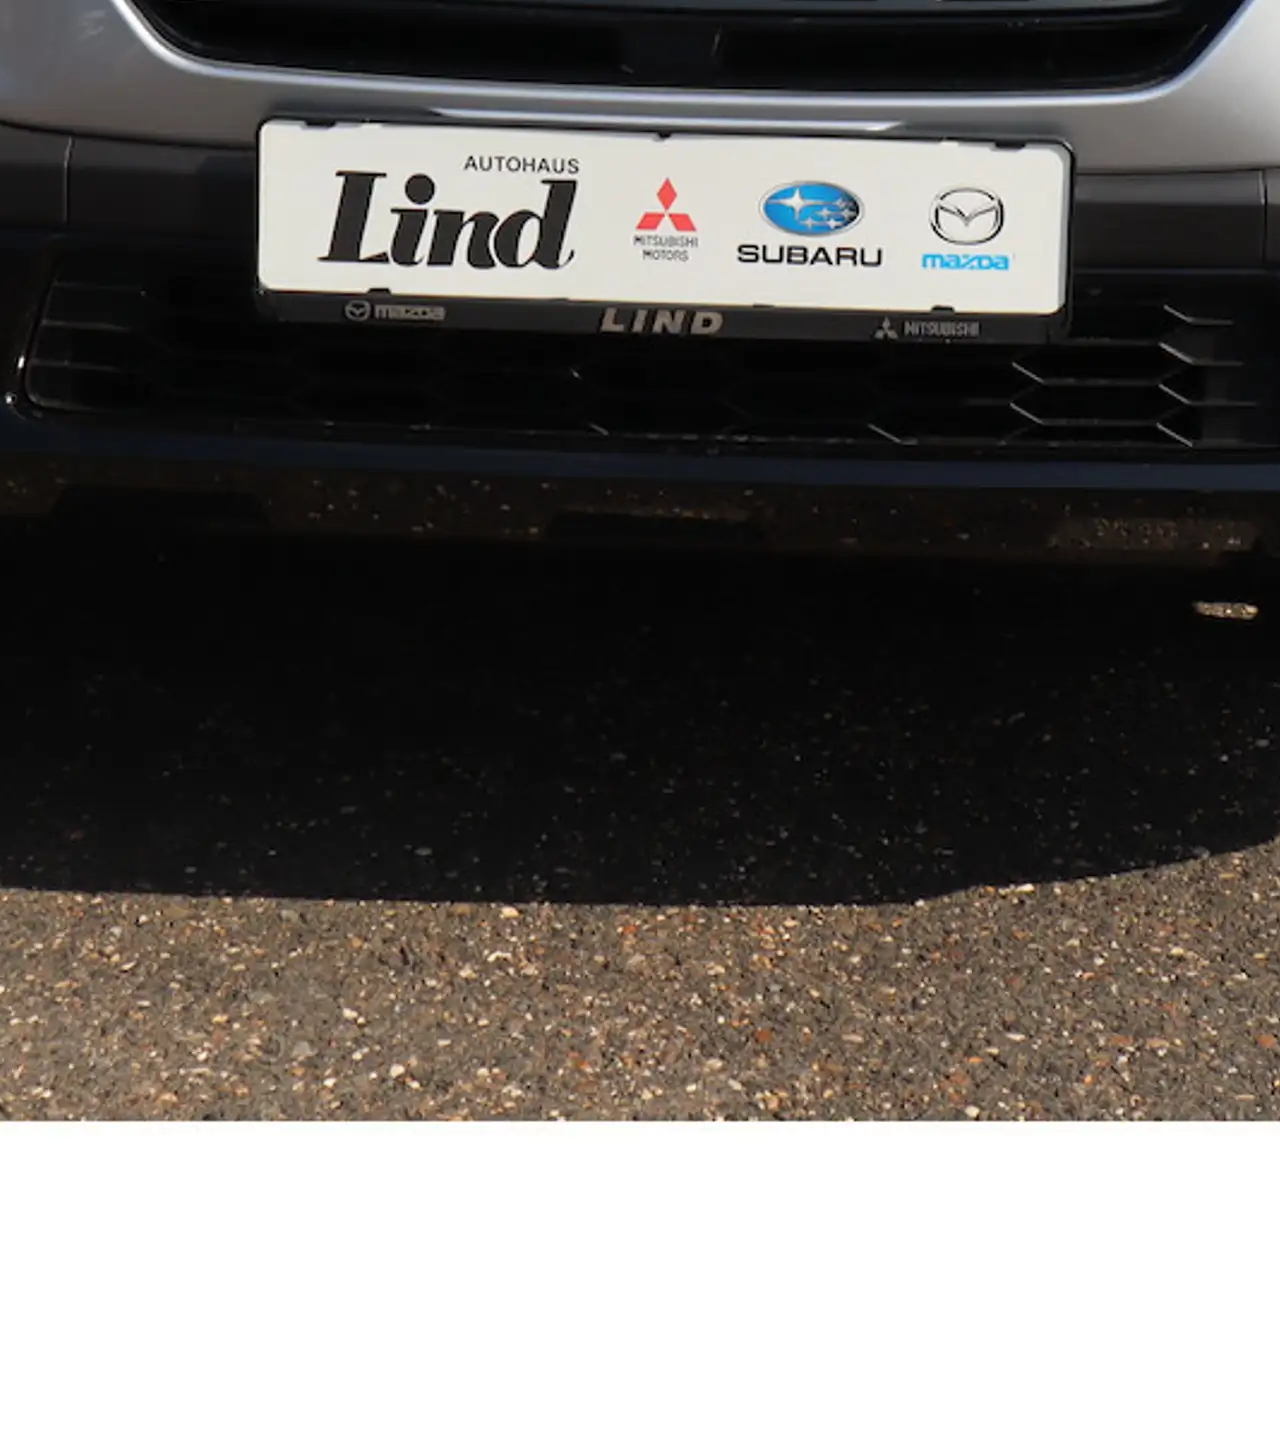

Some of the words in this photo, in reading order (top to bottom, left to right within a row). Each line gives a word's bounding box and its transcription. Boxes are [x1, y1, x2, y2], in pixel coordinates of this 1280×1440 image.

[463, 155, 580, 175] AUTOHAUS
[317, 170, 578, 270] Lind
[633, 235, 699, 249] MITSUBISHI
[642, 249, 690, 262] MOTORS
[737, 244, 883, 268] SUBARU
[921, 253, 1011, 271] mazda
[374, 303, 447, 322] mazda
[600, 307, 724, 335] LIND
[903, 320, 981, 337] MITSUBISHI
